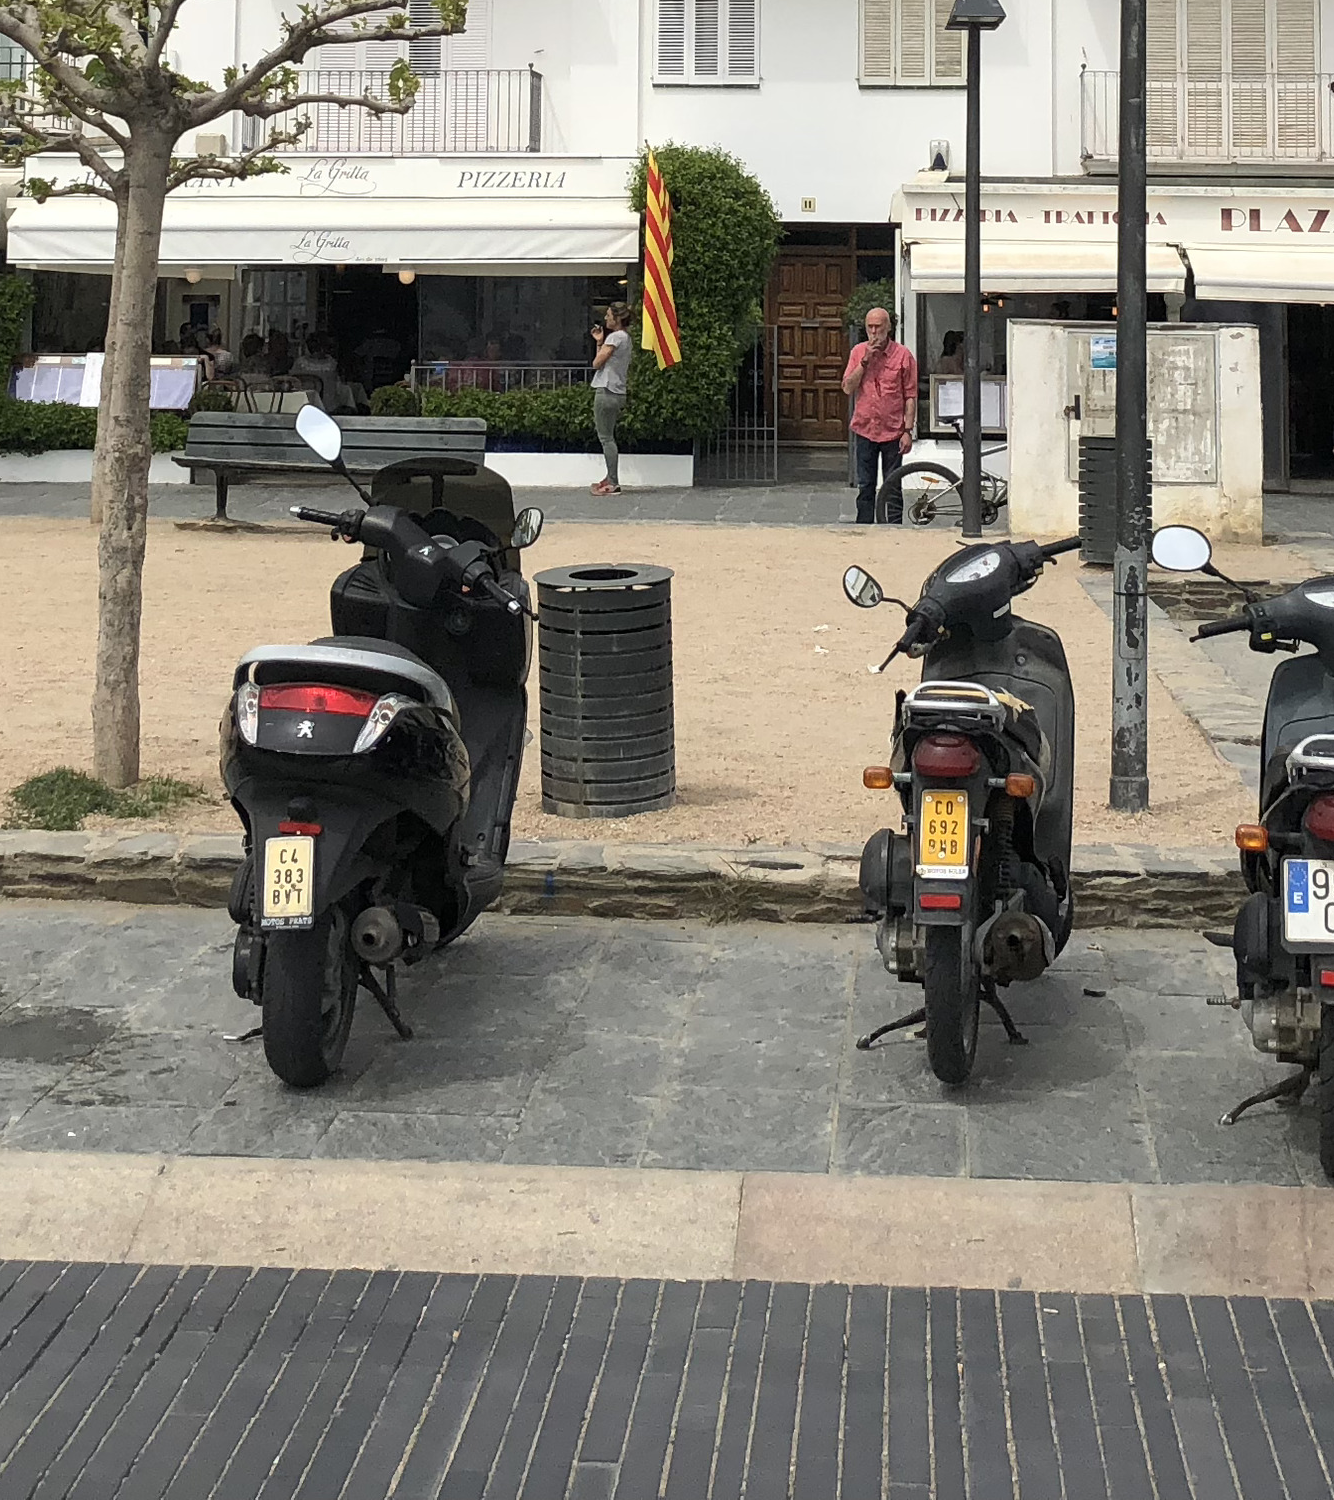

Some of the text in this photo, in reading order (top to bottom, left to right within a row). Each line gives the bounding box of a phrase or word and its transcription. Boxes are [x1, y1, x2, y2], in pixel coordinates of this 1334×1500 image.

[297, 158, 323, 182] La
[457, 171, 567, 188] PIZZERIA
[915, 207, 1018, 223] PIZZRIA
[289, 230, 312, 250] La
[929, 820, 958, 835] 692
[280, 848, 298, 864] C4
[274, 868, 304, 884] 383
[273, 889, 303, 904] BVT
[1293, 892, 1304, 905] E
